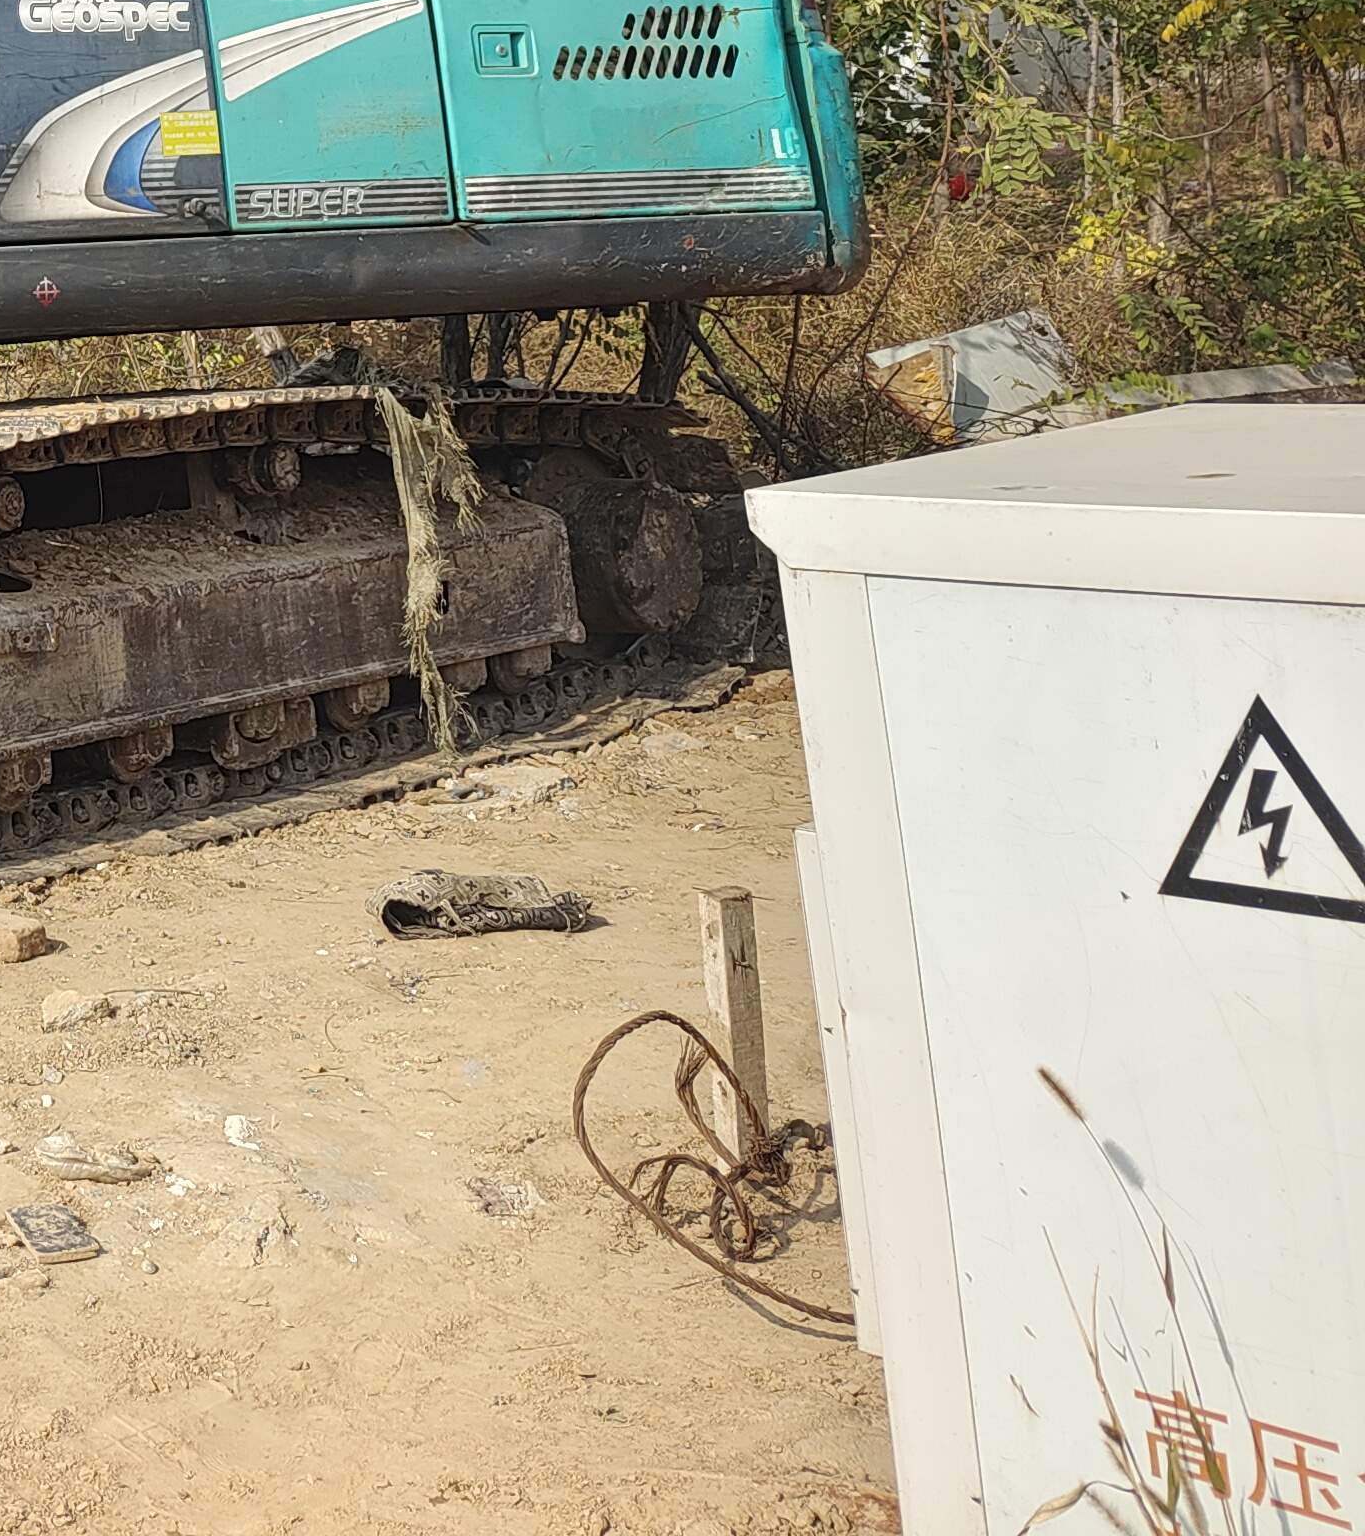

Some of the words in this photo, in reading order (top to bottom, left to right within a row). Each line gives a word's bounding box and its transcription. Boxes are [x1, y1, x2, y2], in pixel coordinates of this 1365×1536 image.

[770, 126, 801, 160] LC
[248, 185, 366, 219] SUPER
[1132, 1387, 1365, 1532] 高压
